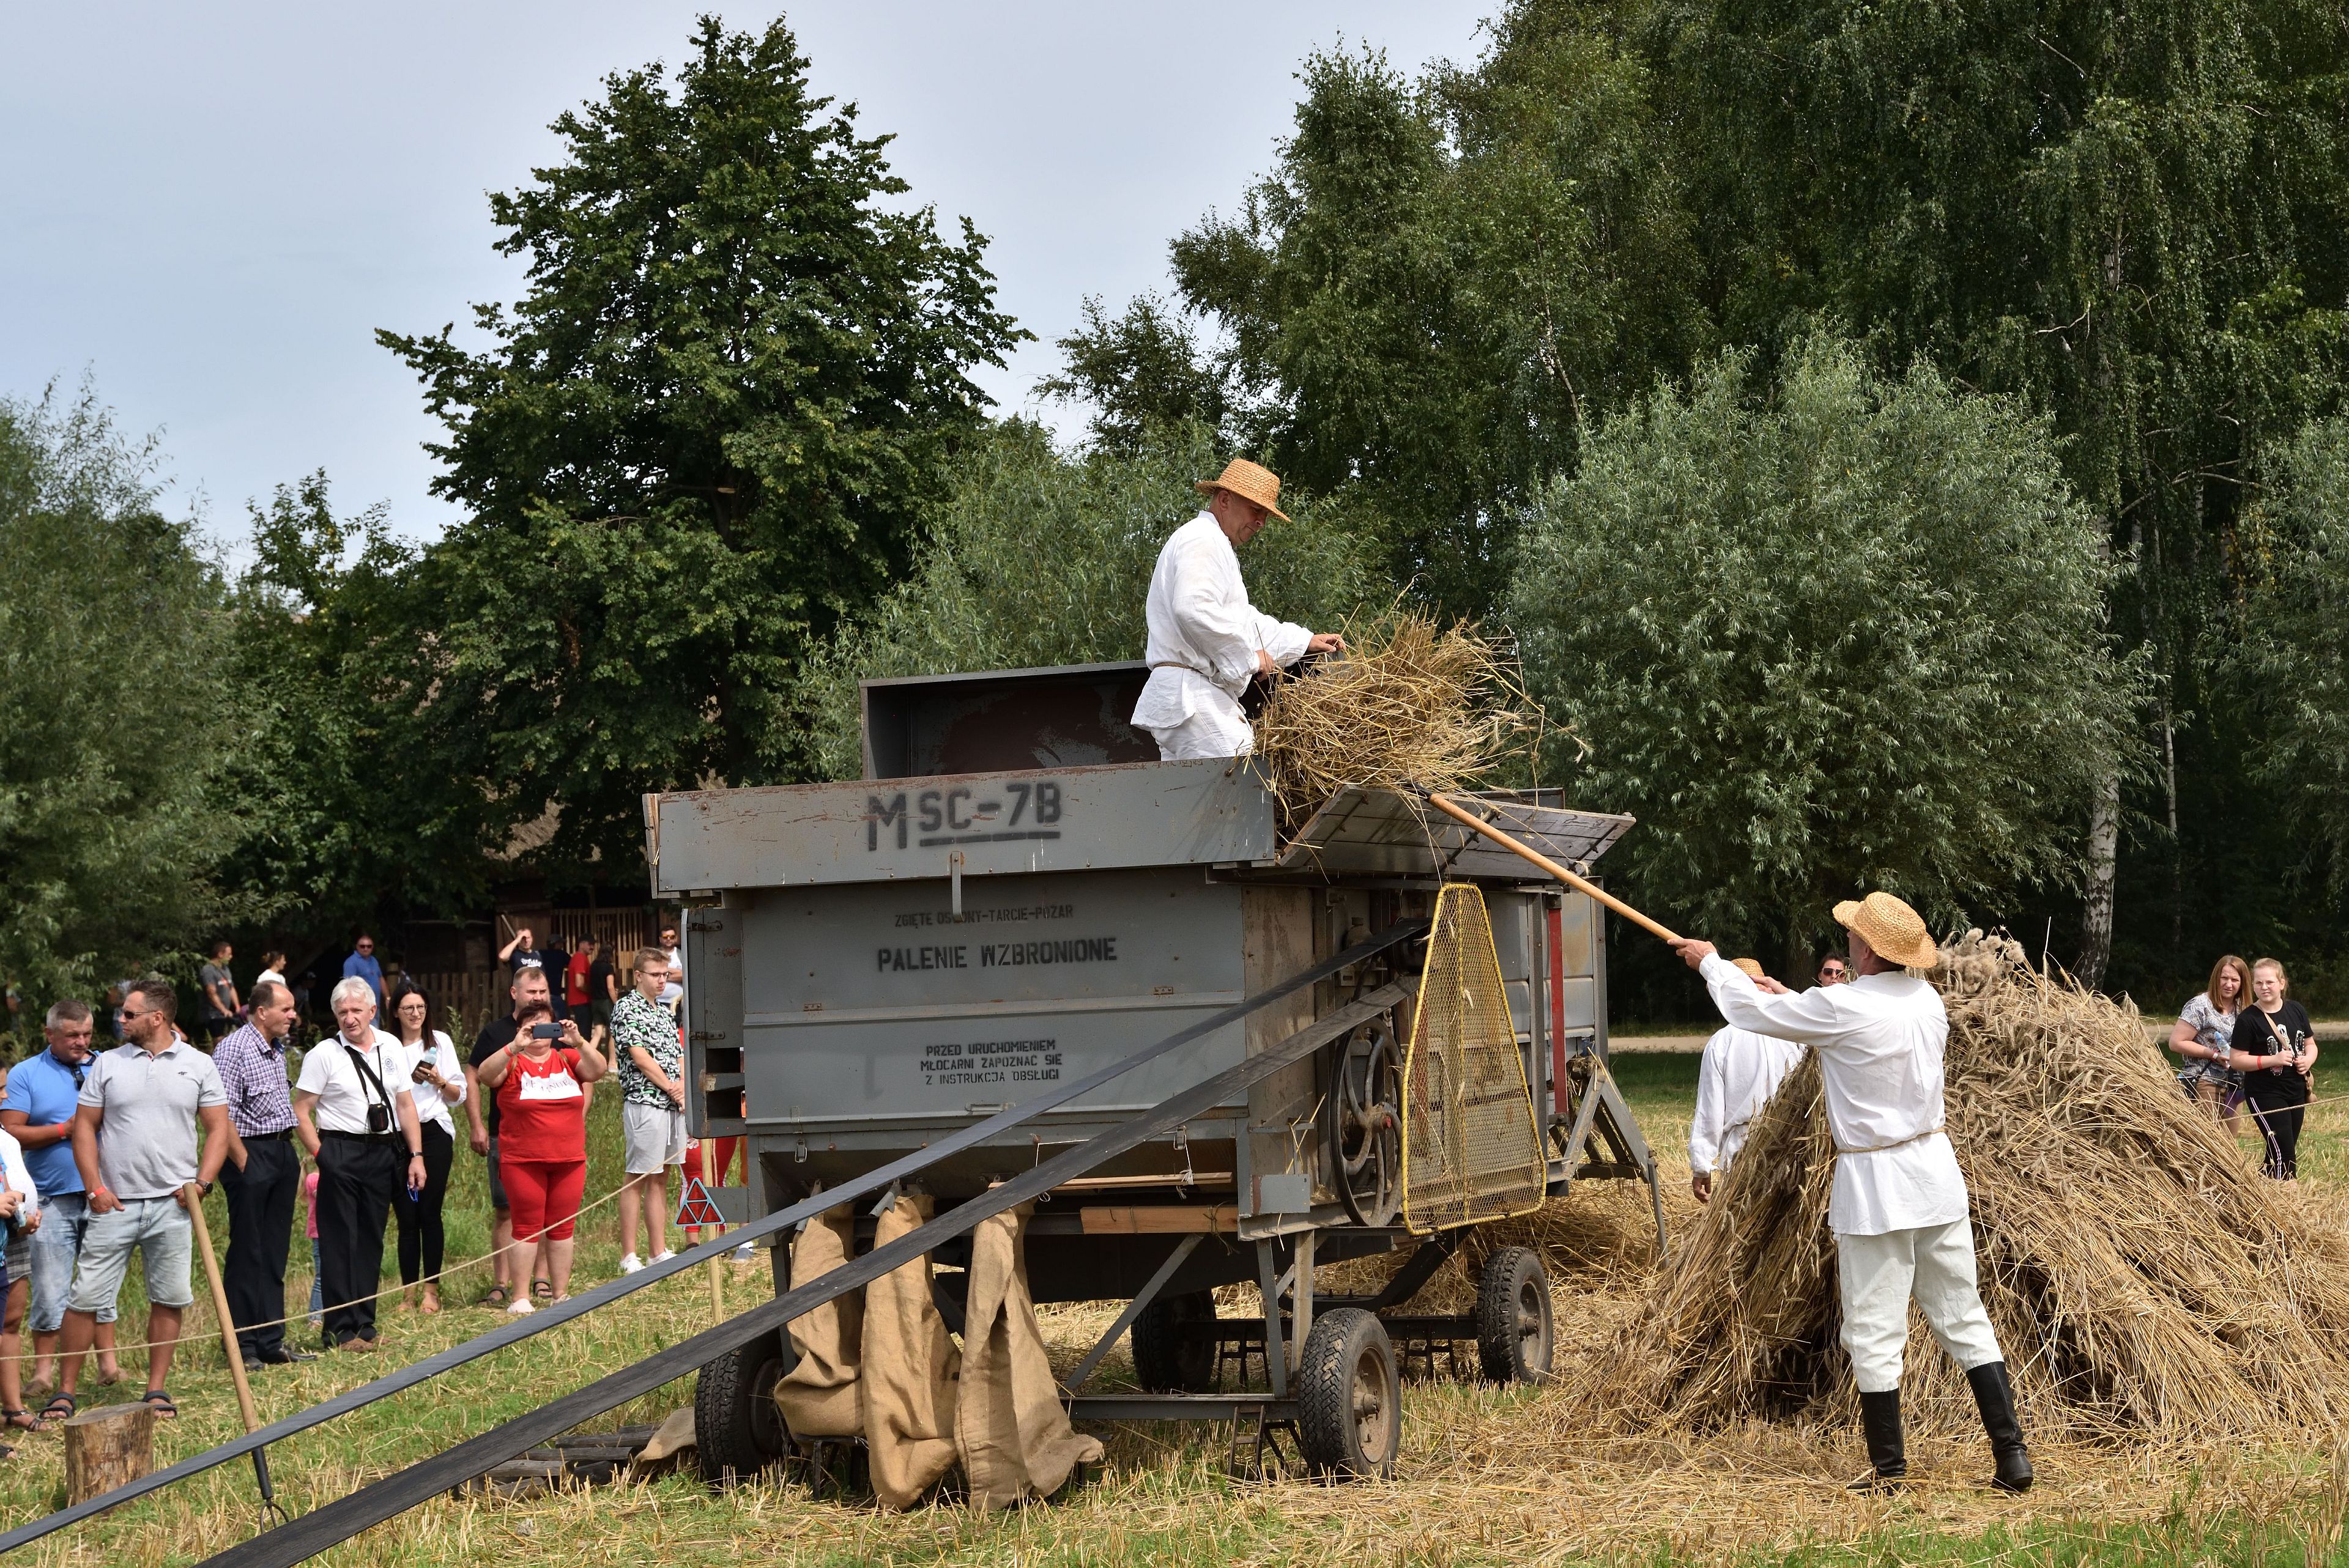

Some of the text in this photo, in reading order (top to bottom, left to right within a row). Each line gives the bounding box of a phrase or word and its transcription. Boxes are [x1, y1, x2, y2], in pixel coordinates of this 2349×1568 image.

[878, 937, 1118, 972] PALENIE WZBRONIONE
[926, 1040, 1056, 1057] PRZED URUCHOMIENIEM
[920, 1059, 974, 1071] MŁOCARNI
[926, 1075, 933, 1085] Z
[1013, 1069, 1059, 1081] OBSŁUGI
